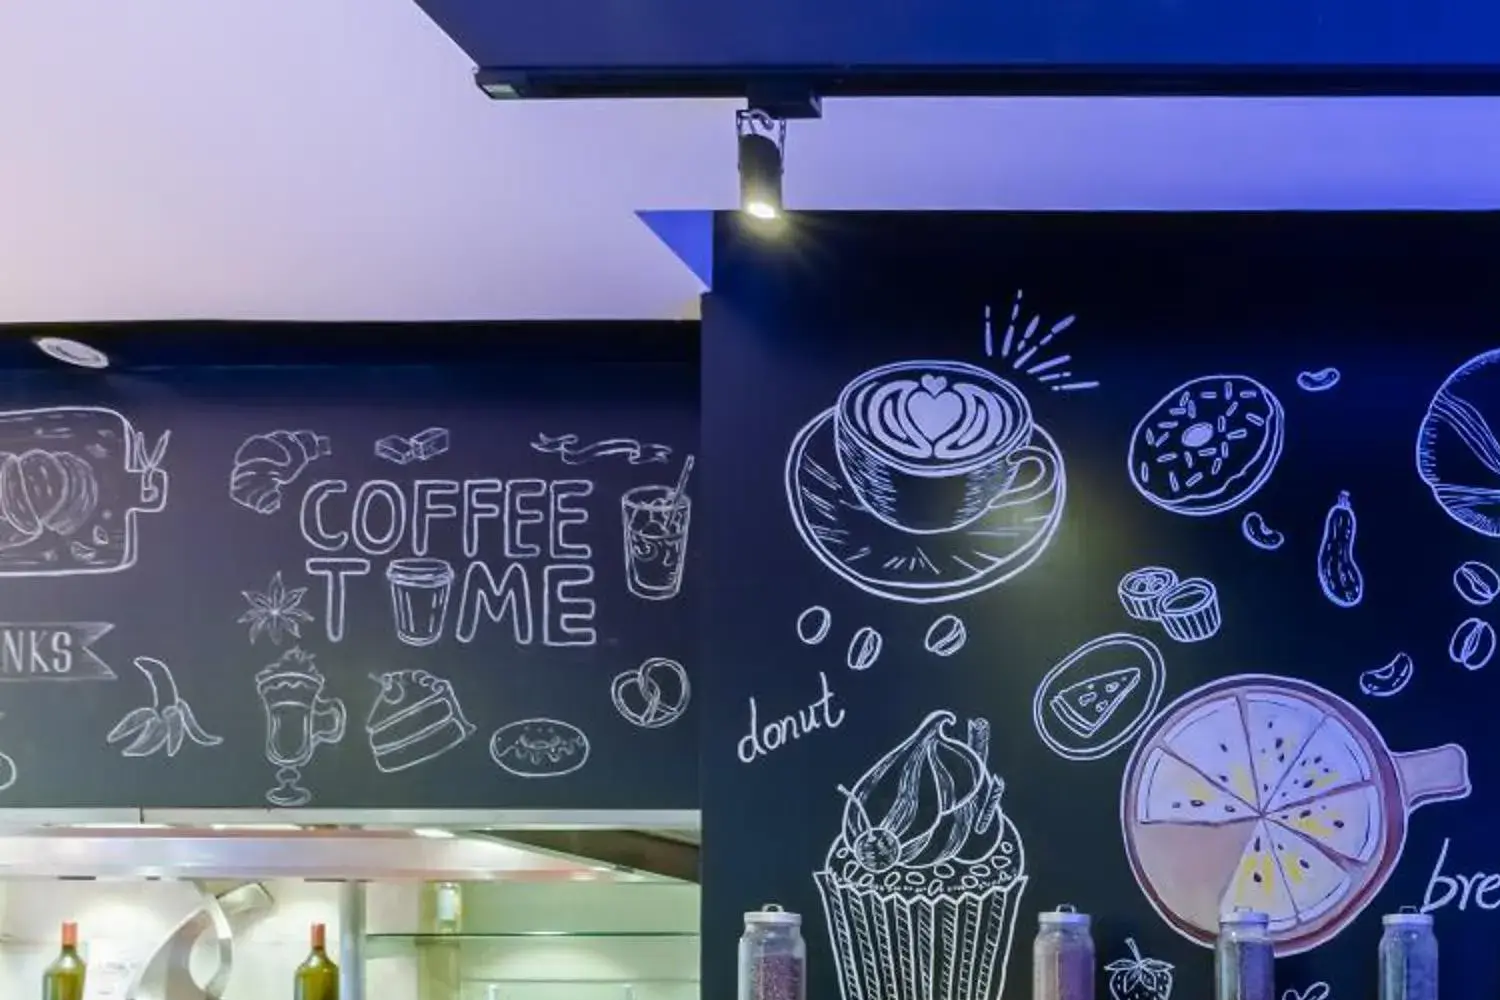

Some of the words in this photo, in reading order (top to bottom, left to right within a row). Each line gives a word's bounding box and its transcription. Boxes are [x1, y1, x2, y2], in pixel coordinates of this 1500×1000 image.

[300, 478, 594, 559] COFFEE
[305, 556, 597, 648] TME
[736, 671, 846, 764] donut
